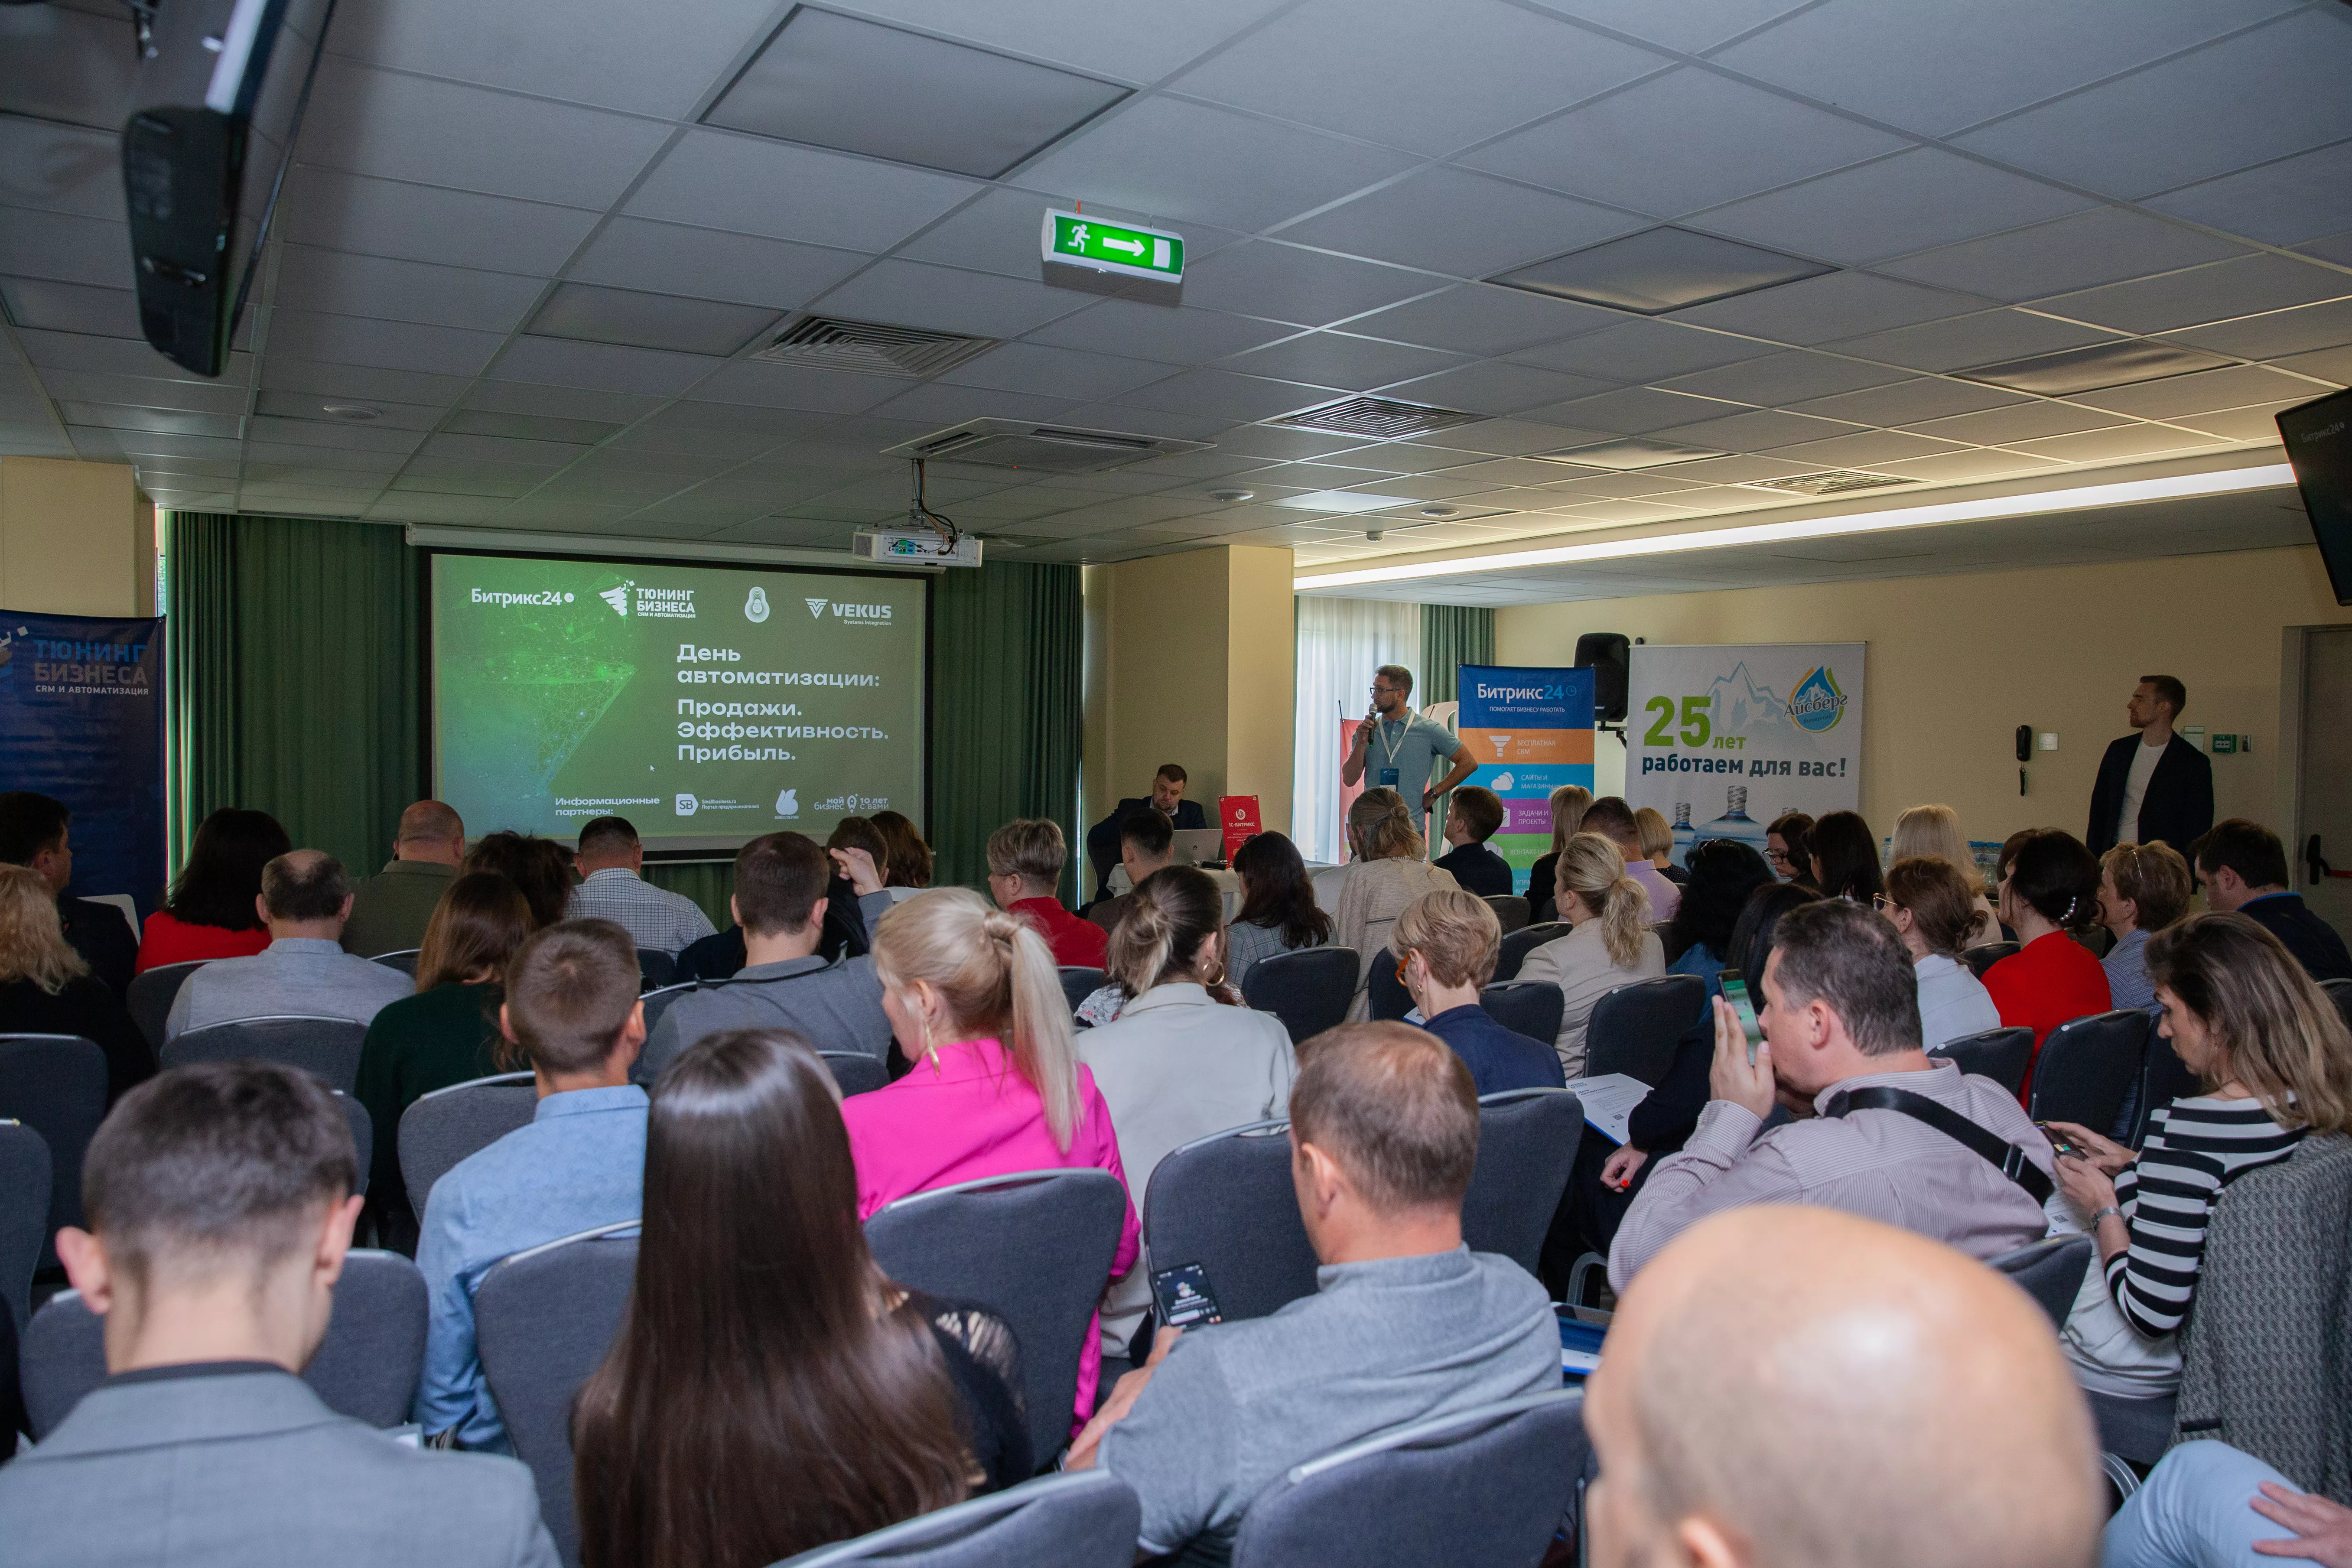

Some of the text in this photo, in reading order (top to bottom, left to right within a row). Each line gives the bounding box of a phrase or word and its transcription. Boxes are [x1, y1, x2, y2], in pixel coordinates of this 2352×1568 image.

[472, 588, 562, 608] Битрикс24
[636, 588, 694, 601] ТЮНИНГ
[637, 600, 695, 613] БИЗНЕСА
[832, 603, 891, 619] VEKUS
[33, 639, 146, 663] ТЮНИНГ
[677, 644, 741, 663] День
[34, 662, 148, 684] БИЗНЕСА
[677, 670, 880, 688] автоматизации:
[68, 686, 149, 696] АВТОМАТИЗАЦИЯ
[1477, 683, 1564, 703] Битрикс24
[678, 699, 802, 718] Продажи.
[1784, 695, 1848, 717] Айсберг
[677, 722, 889, 741] Эффективность.
[1644, 696, 1746, 749] 25 лет
[678, 745, 796, 764] Прибыль.
[1642, 753, 1846, 777] работаем для вас!
[556, 797, 660, 807] Информационные
[680, 800, 693, 809] SB
[556, 808, 613, 817] партнеры:
